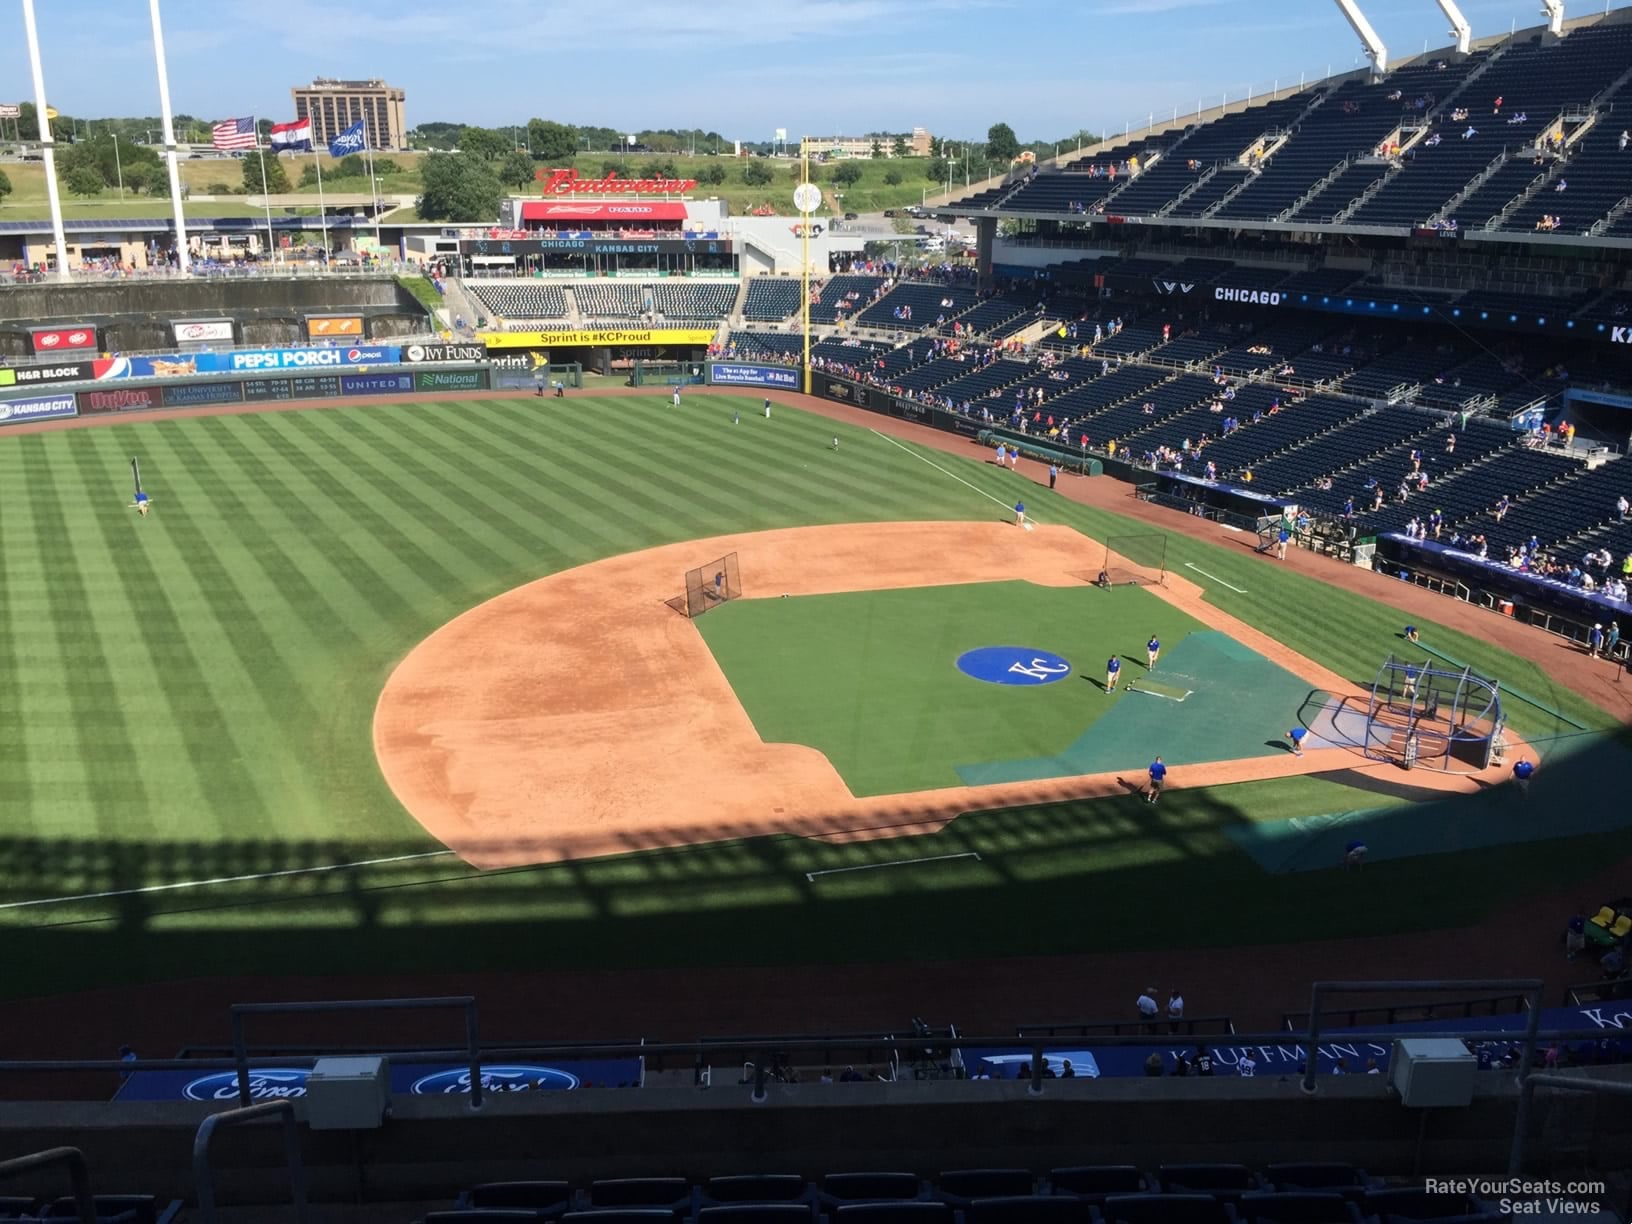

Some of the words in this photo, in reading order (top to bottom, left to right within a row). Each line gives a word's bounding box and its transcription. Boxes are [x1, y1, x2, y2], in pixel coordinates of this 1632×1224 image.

[535, 167, 698, 196] Budweiser
[541, 240, 585, 248] CHICAGO
[595, 244, 635, 253] KANSAS
[637, 244, 659, 252] CITY
[1215, 287, 1280, 305] CHICAGO
[541, 333, 577, 344] Sprint
[580, 332, 590, 341] is
[592, 331, 651, 342] #KCProud
[234, 352, 279, 369] PEPSI
[282, 350, 341, 366] PORCH
[361, 352, 382, 360] pepsi
[425, 346, 443, 360] IVY
[445, 345, 482, 360] FUNDS
[17, 369, 41, 381] H&R
[42, 367, 80, 379] BLOCK
[434, 373, 479, 385] National
[346, 380, 396, 390] UNITED
[13, 402, 51, 415] KANSAS
[52, 400, 73, 411] CITY
[1168, 1043, 1360, 1067] KUFFMAN
